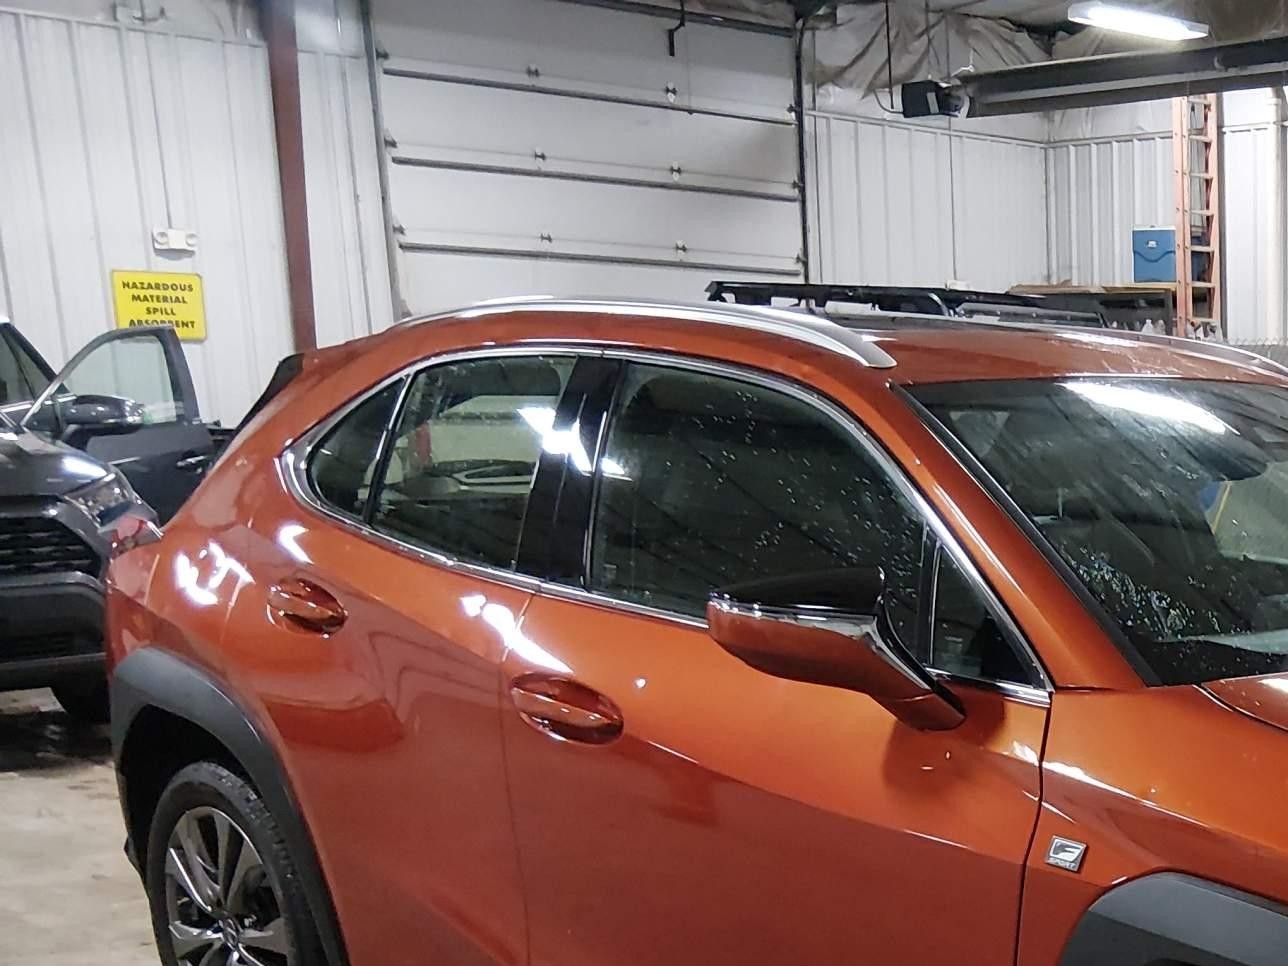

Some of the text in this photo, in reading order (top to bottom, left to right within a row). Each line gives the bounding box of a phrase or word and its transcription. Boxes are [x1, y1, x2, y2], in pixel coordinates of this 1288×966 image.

[122, 281, 194, 292] HAZARDOUS
[131, 294, 188, 304] MATERIAL
[145, 306, 176, 316] SPILL
